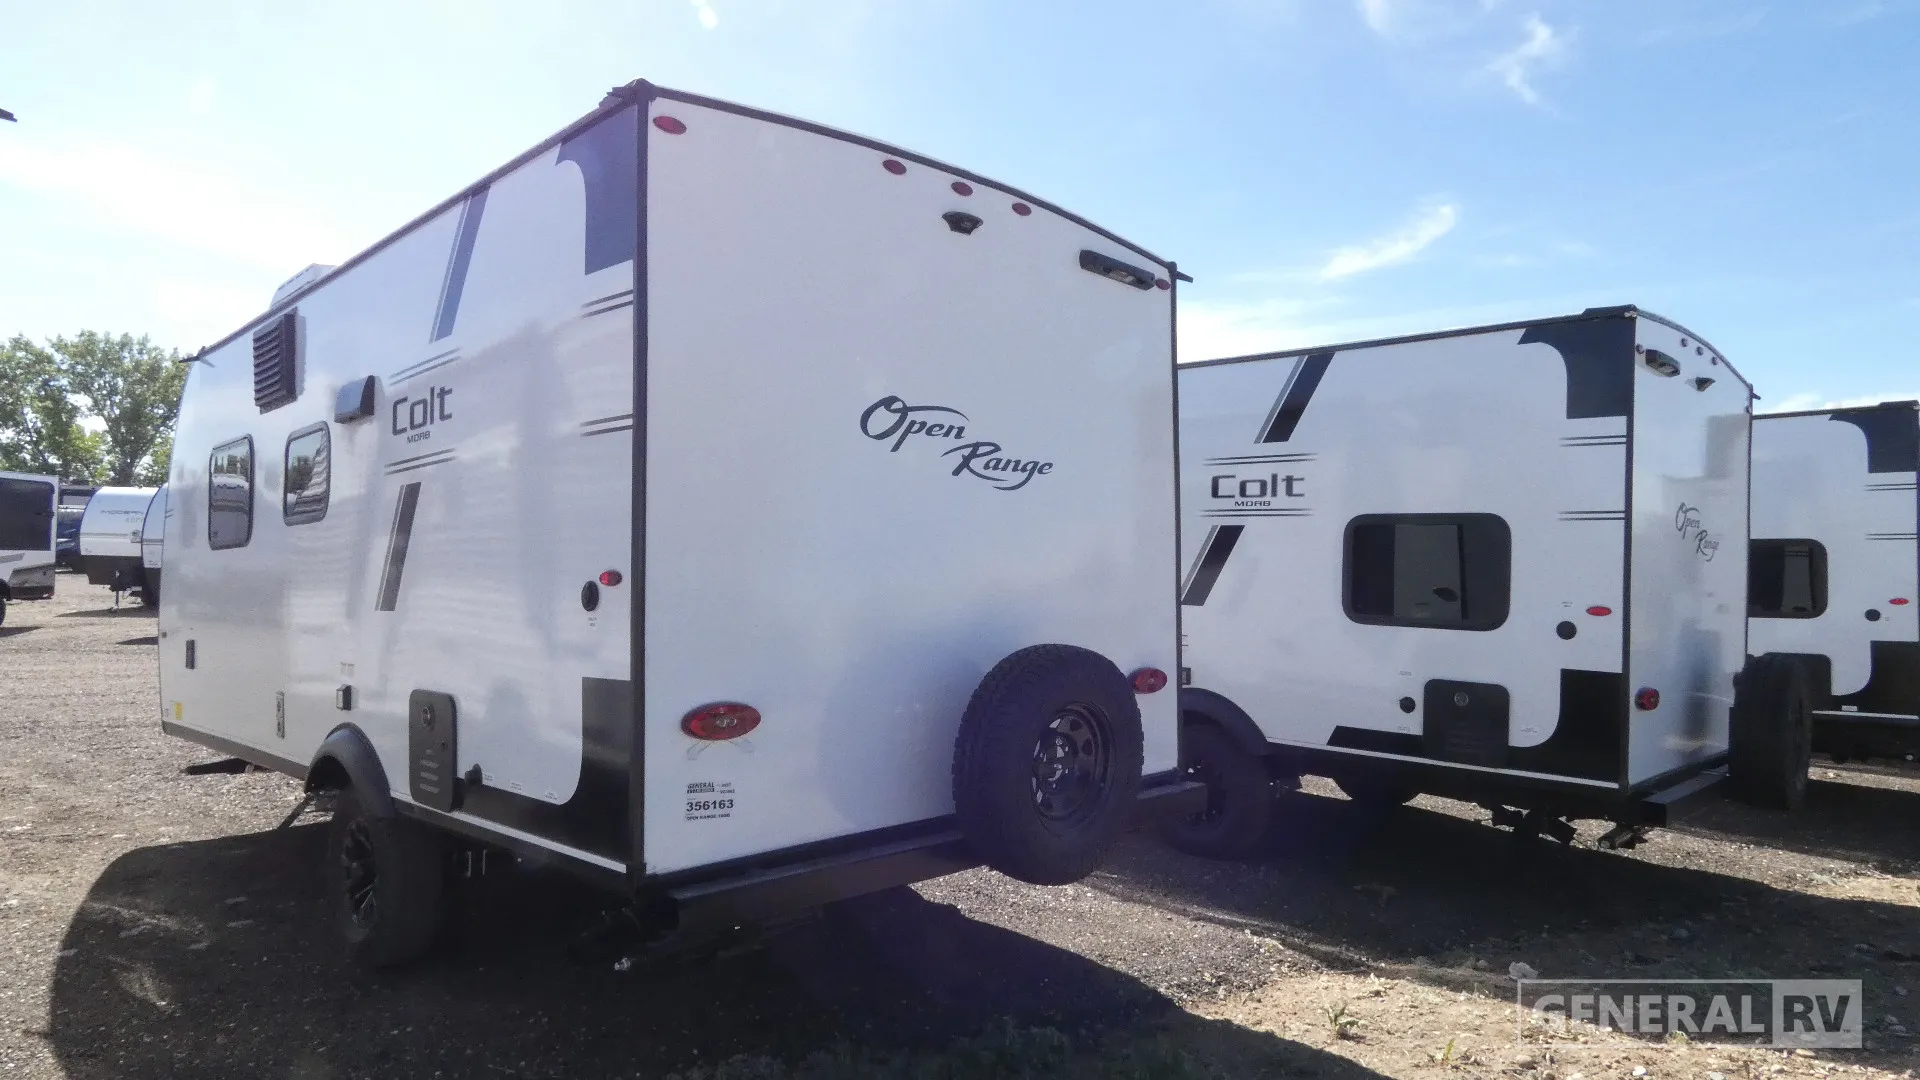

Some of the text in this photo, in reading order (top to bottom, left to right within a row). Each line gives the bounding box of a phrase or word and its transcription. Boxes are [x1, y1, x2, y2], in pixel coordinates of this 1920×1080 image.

[392, 386, 453, 436] Colt
[860, 395, 970, 452] Open
[407, 431, 431, 444] MOAB
[940, 441, 1054, 491] Range
[1211, 473, 1305, 499] Colt
[686, 799, 734, 812] 356163
